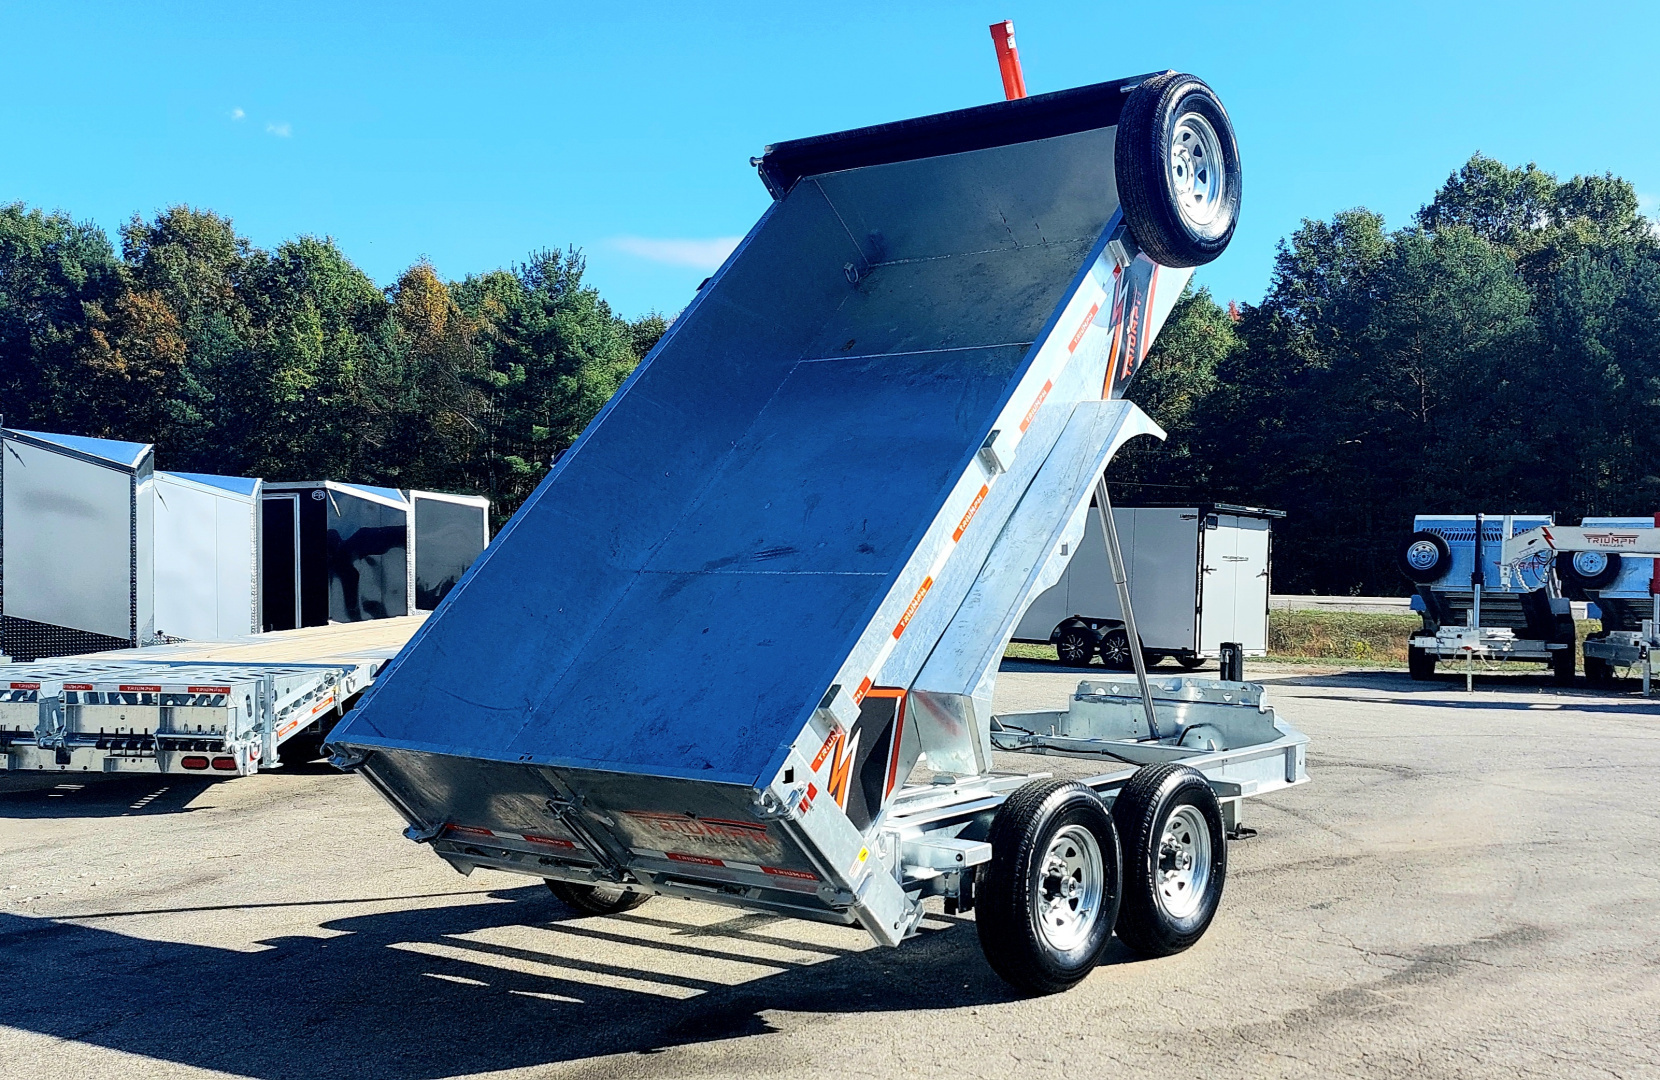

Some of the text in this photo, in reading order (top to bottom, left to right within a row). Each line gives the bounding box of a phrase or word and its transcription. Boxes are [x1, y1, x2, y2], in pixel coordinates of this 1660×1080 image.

[1074, 312, 1093, 344] TRIUMPH
[1126, 291, 1142, 376] TRIUMPH
[1026, 389, 1047, 423] TRIUMPH
[959, 495, 983, 532] TRIUMPH
[1587, 536, 1636, 545] TRIUMPH
[900, 587, 927, 628] TRIUMPH
[639, 818, 772, 844] TRIUMPH
[676, 855, 714, 865] TRIUMPH
[772, 869, 814, 879] TRIUMPH
